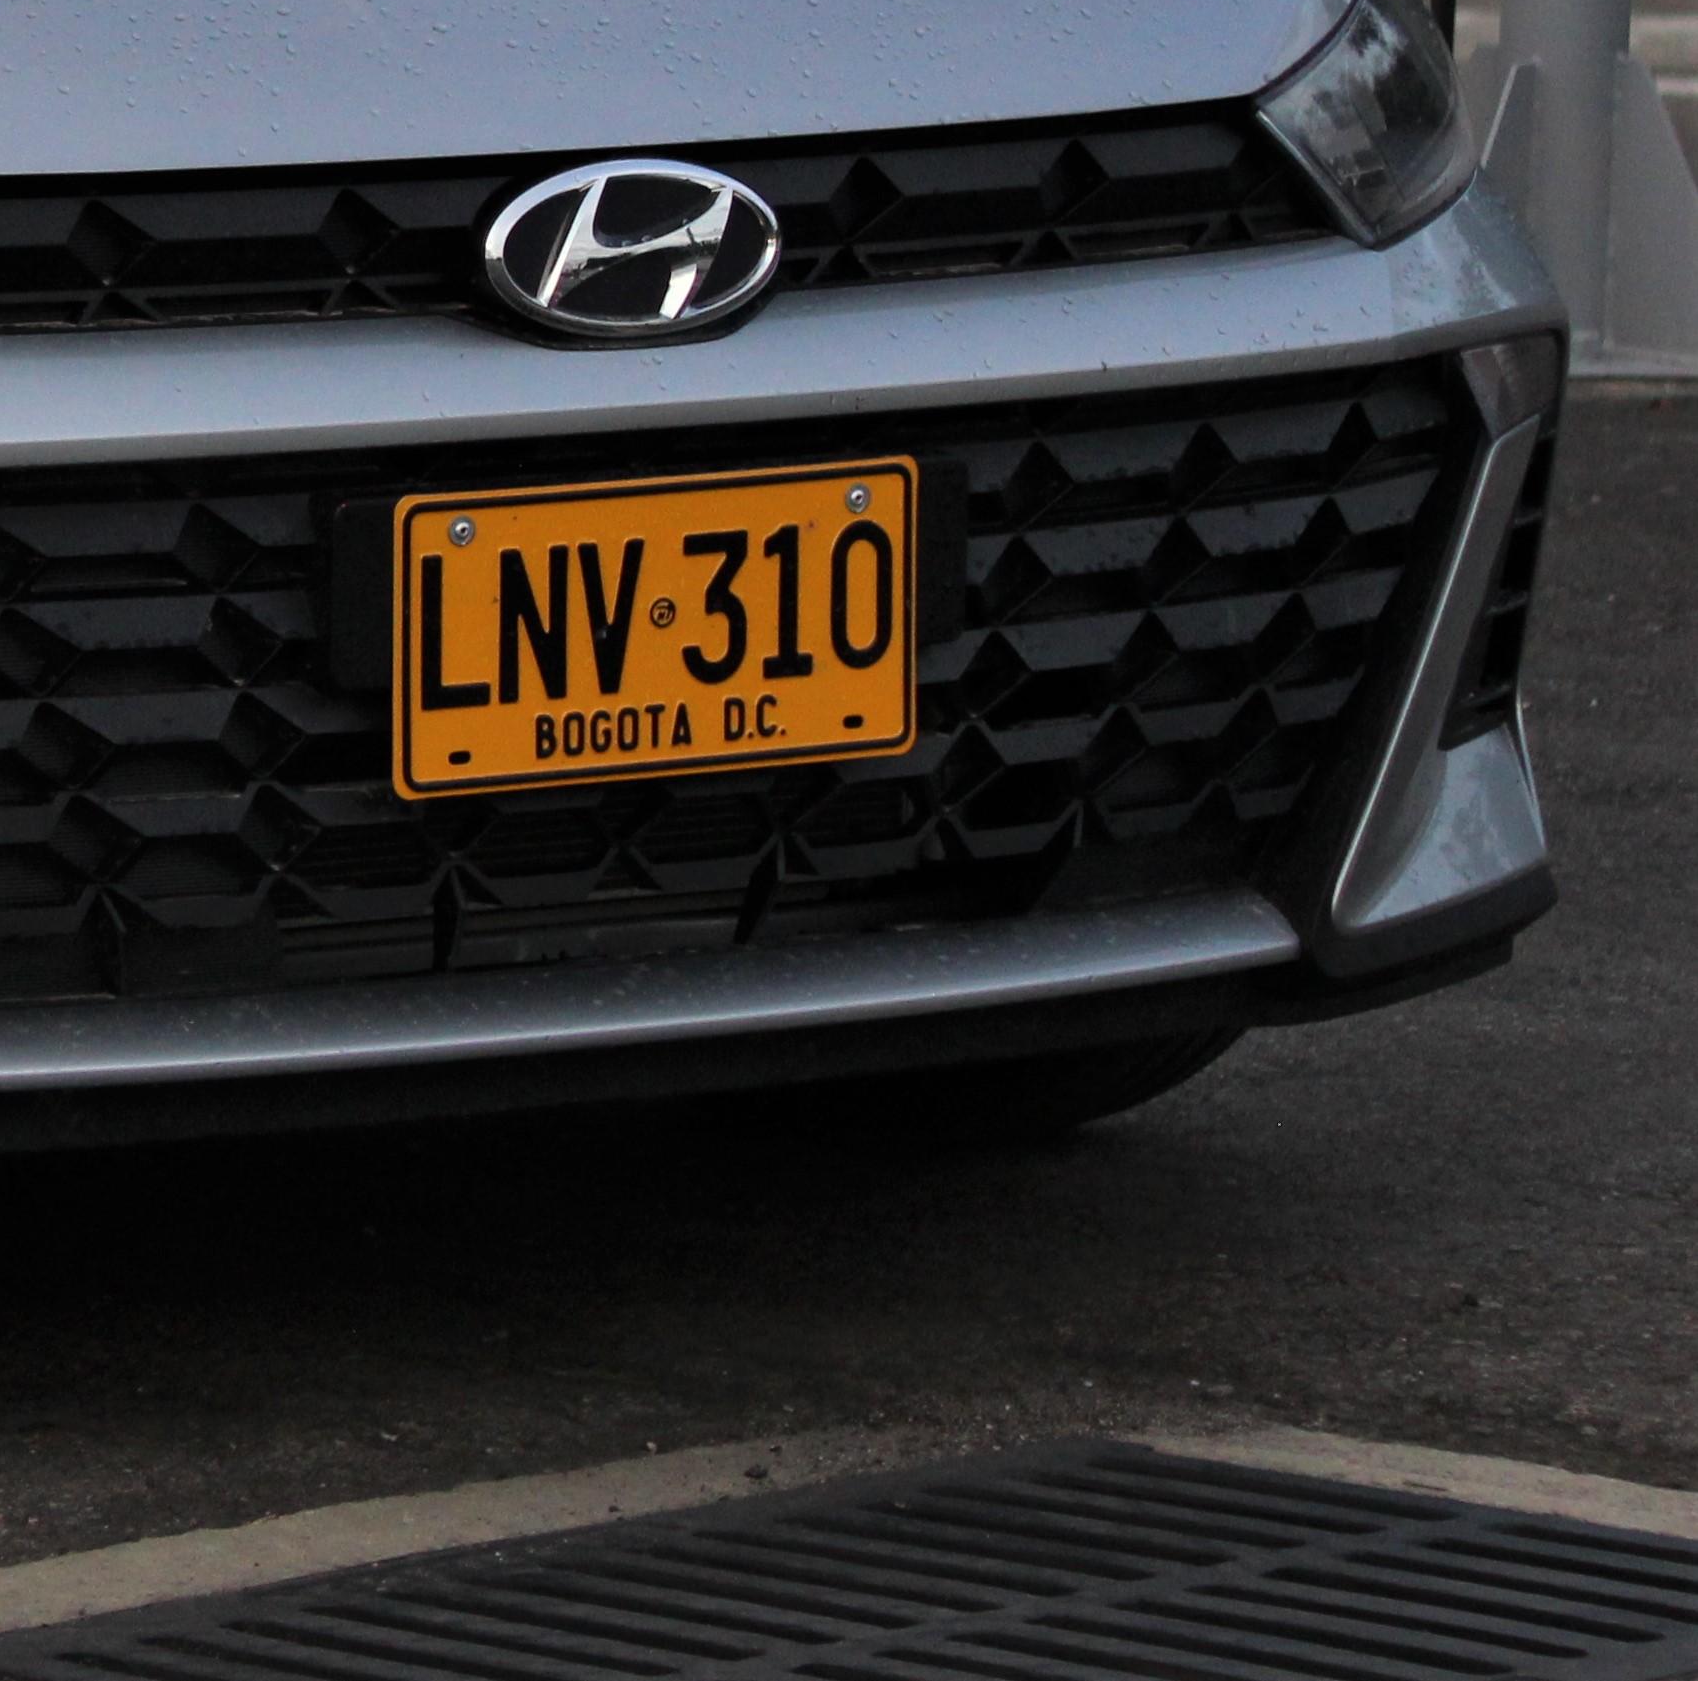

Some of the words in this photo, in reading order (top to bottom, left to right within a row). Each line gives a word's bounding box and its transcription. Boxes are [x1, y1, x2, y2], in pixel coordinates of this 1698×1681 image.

[420, 537, 644, 711] LNV
[681, 519, 893, 685] 310
[535, 702, 692, 759] BOGOTA
[723, 694, 787, 741] D.C.
